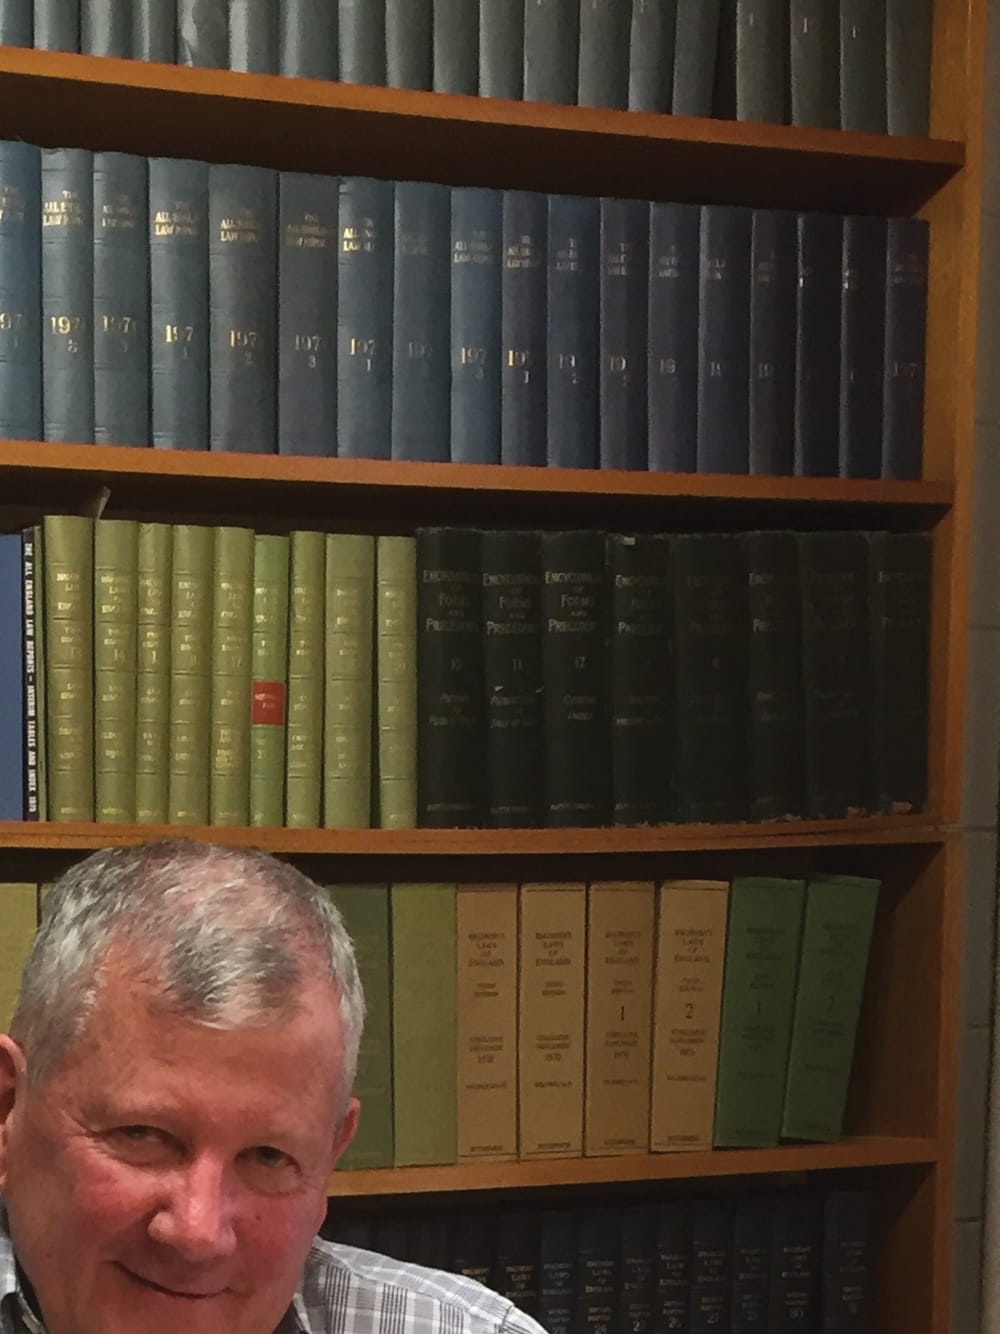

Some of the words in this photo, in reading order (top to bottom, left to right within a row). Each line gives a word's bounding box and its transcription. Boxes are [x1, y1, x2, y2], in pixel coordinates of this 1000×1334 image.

[24, 543, 33, 556] THE
[25, 562, 33, 576] ALL
[25, 580, 34, 615] ENGLAND
[26, 619, 34, 636] LAW
[26, 641, 35, 673] REPORTS
[27, 721, 36, 746] TABLES
[28, 751, 36, 766] AND
[28, 769, 37, 791] INDEX
[620, 1006, 625, 1021] 1
[685, 1003, 693, 1019] 2
